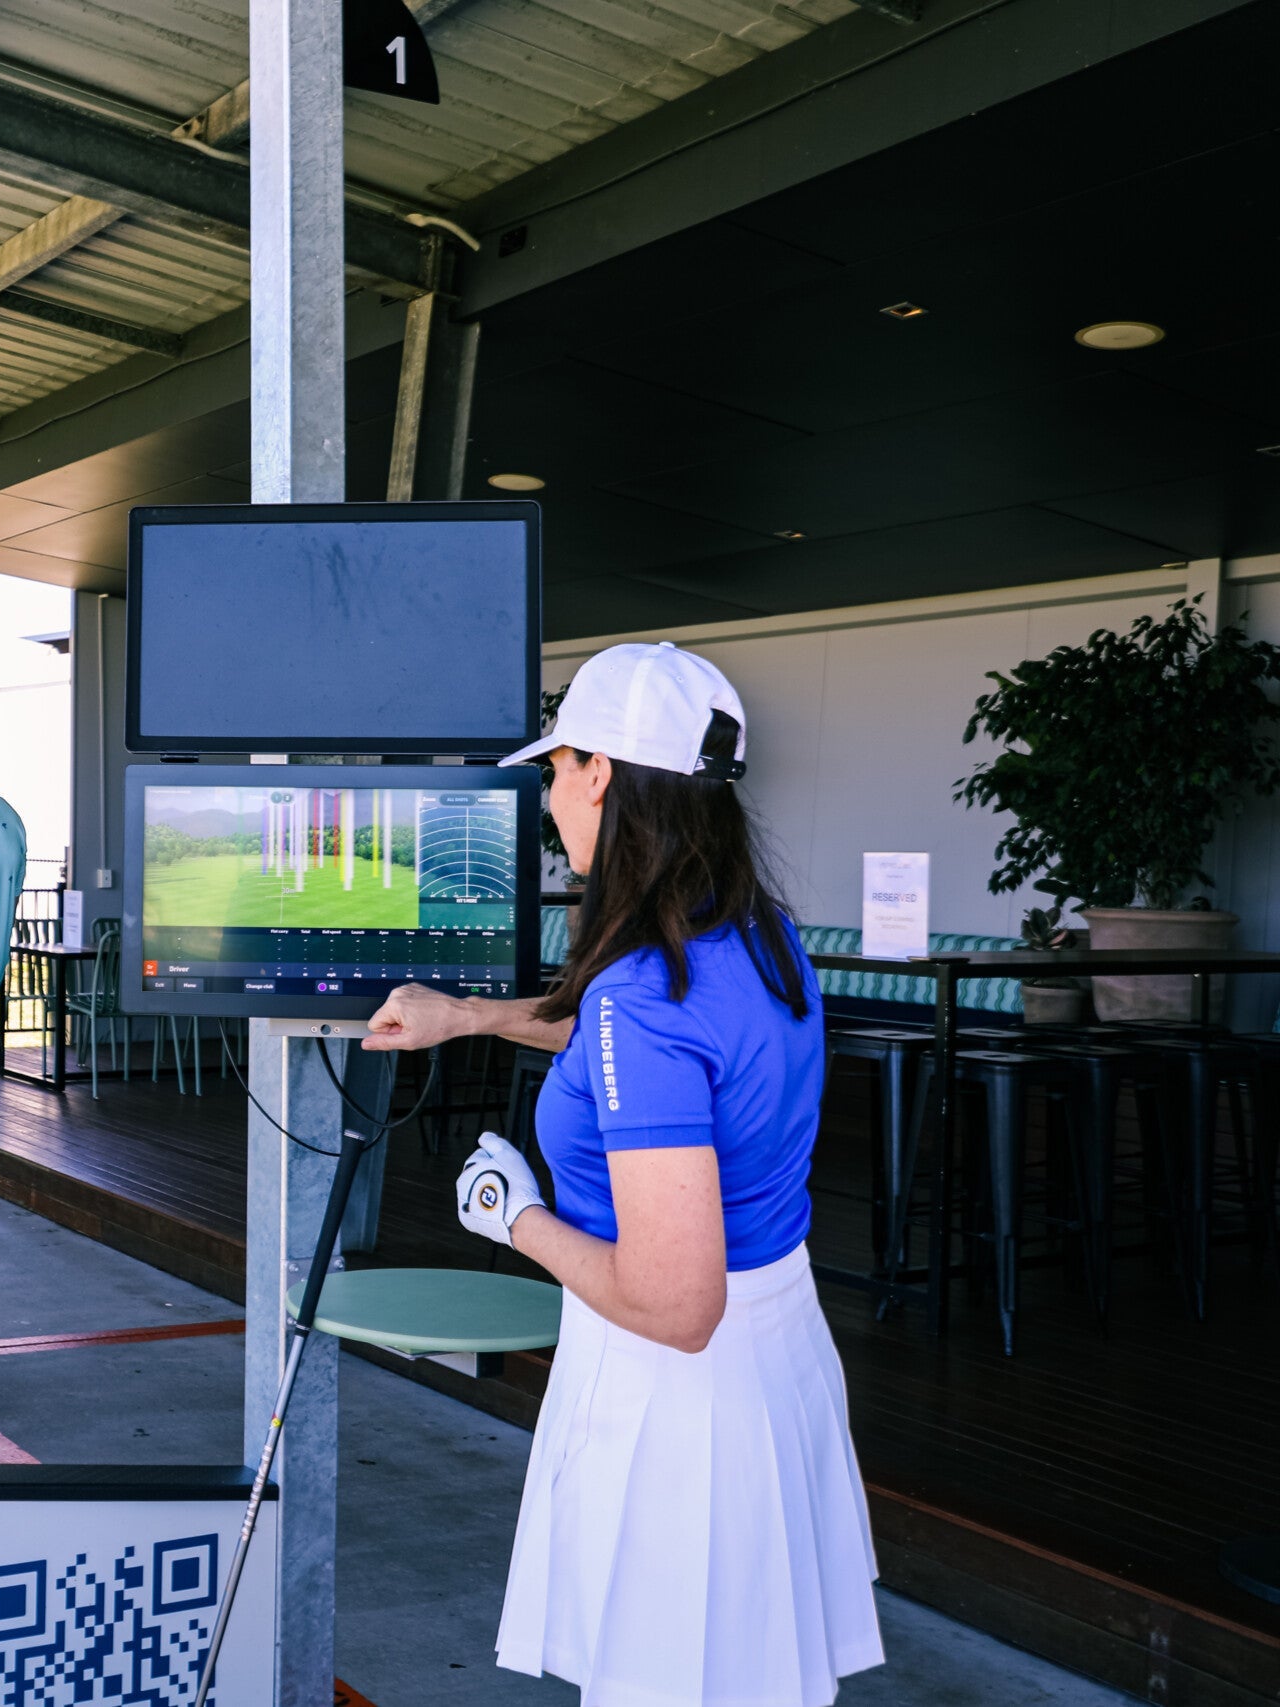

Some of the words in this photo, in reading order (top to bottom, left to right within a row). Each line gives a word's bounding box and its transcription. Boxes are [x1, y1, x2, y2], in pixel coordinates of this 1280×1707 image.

[385, 36, 406, 85] 1
[871, 892, 917, 903] RESERVED
[599, 996, 619, 1111] J.LINDEBERG
